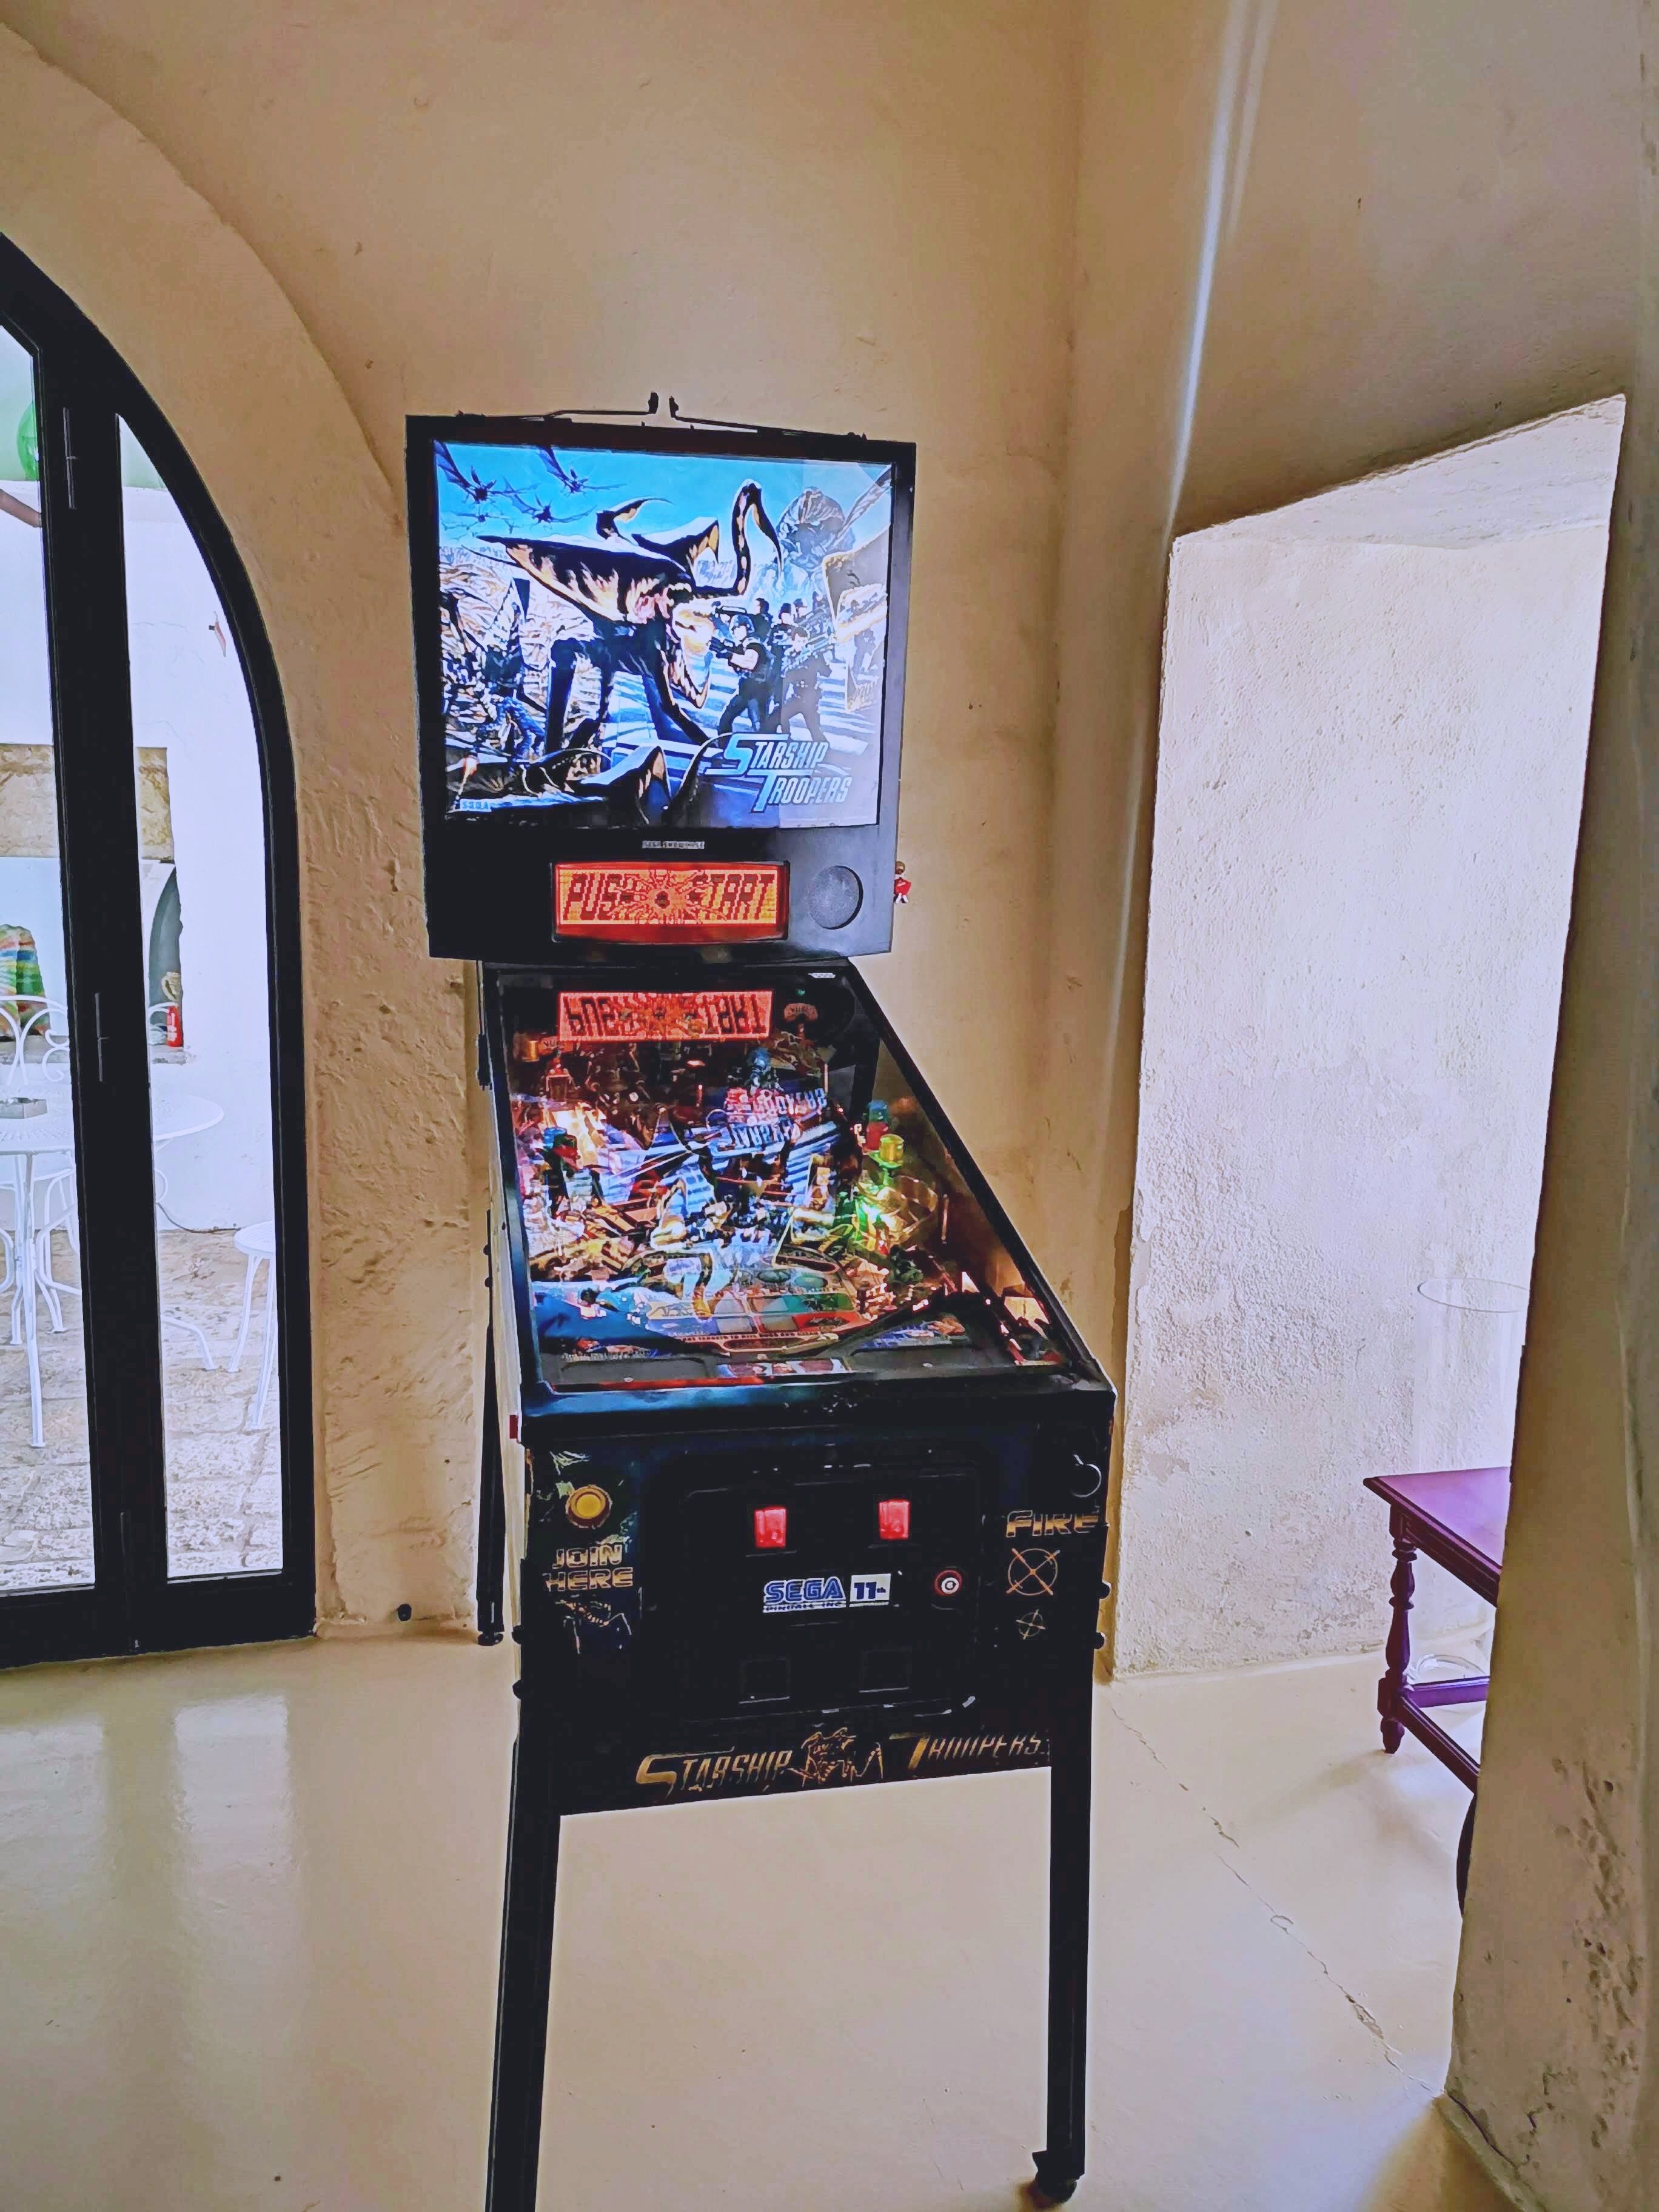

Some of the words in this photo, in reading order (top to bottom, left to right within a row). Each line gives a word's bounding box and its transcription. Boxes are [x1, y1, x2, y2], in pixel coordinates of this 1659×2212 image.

[704, 732, 829, 776] STARSHIP
[748, 769, 852, 812] TROOPERS
[1006, 1506, 1099, 1538] FIRE
[552, 1544, 623, 1569] JOIN
[542, 1566, 633, 1592] HERE
[764, 1577, 845, 1604] SEGA
[635, 1746, 793, 1800] STARSHIP
